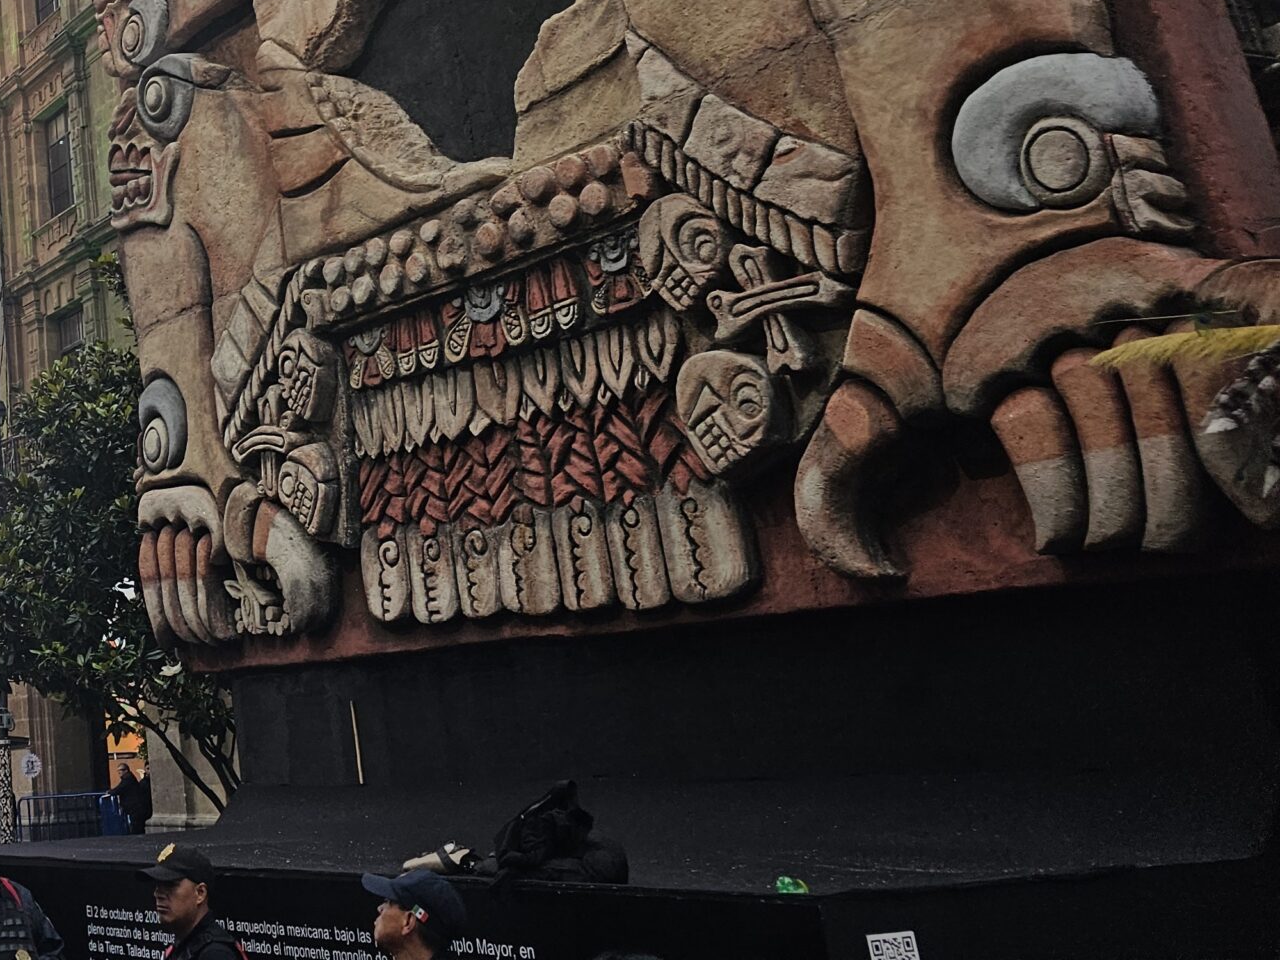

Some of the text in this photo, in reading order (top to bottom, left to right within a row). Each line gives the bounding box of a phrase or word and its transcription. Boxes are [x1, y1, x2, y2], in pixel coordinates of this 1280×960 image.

[86, 905, 93, 918] El
[93, 906, 99, 918] 2
[100, 906, 108, 919] de
[109, 907, 133, 920] octubre
[134, 909, 143, 922] de
[226, 917, 234, 931] la
[236, 920, 285, 938] arqueología
[286, 924, 333, 940] mexicana:
[334, 926, 355, 945] bajo
[357, 928, 372, 944] las
[476, 938, 516, 960] Mayor,
[519, 945, 535, 959] en
[87, 923, 104, 936] pleno
[105, 926, 131, 939] corazón
[133, 927, 142, 940] de
[143, 928, 149, 941] la
[241, 938, 271, 954] hallado
[273, 941, 282, 955] el
[283, 943, 330, 960] imponente
[88, 940, 160, 960] de la Tierra. Tallada en
